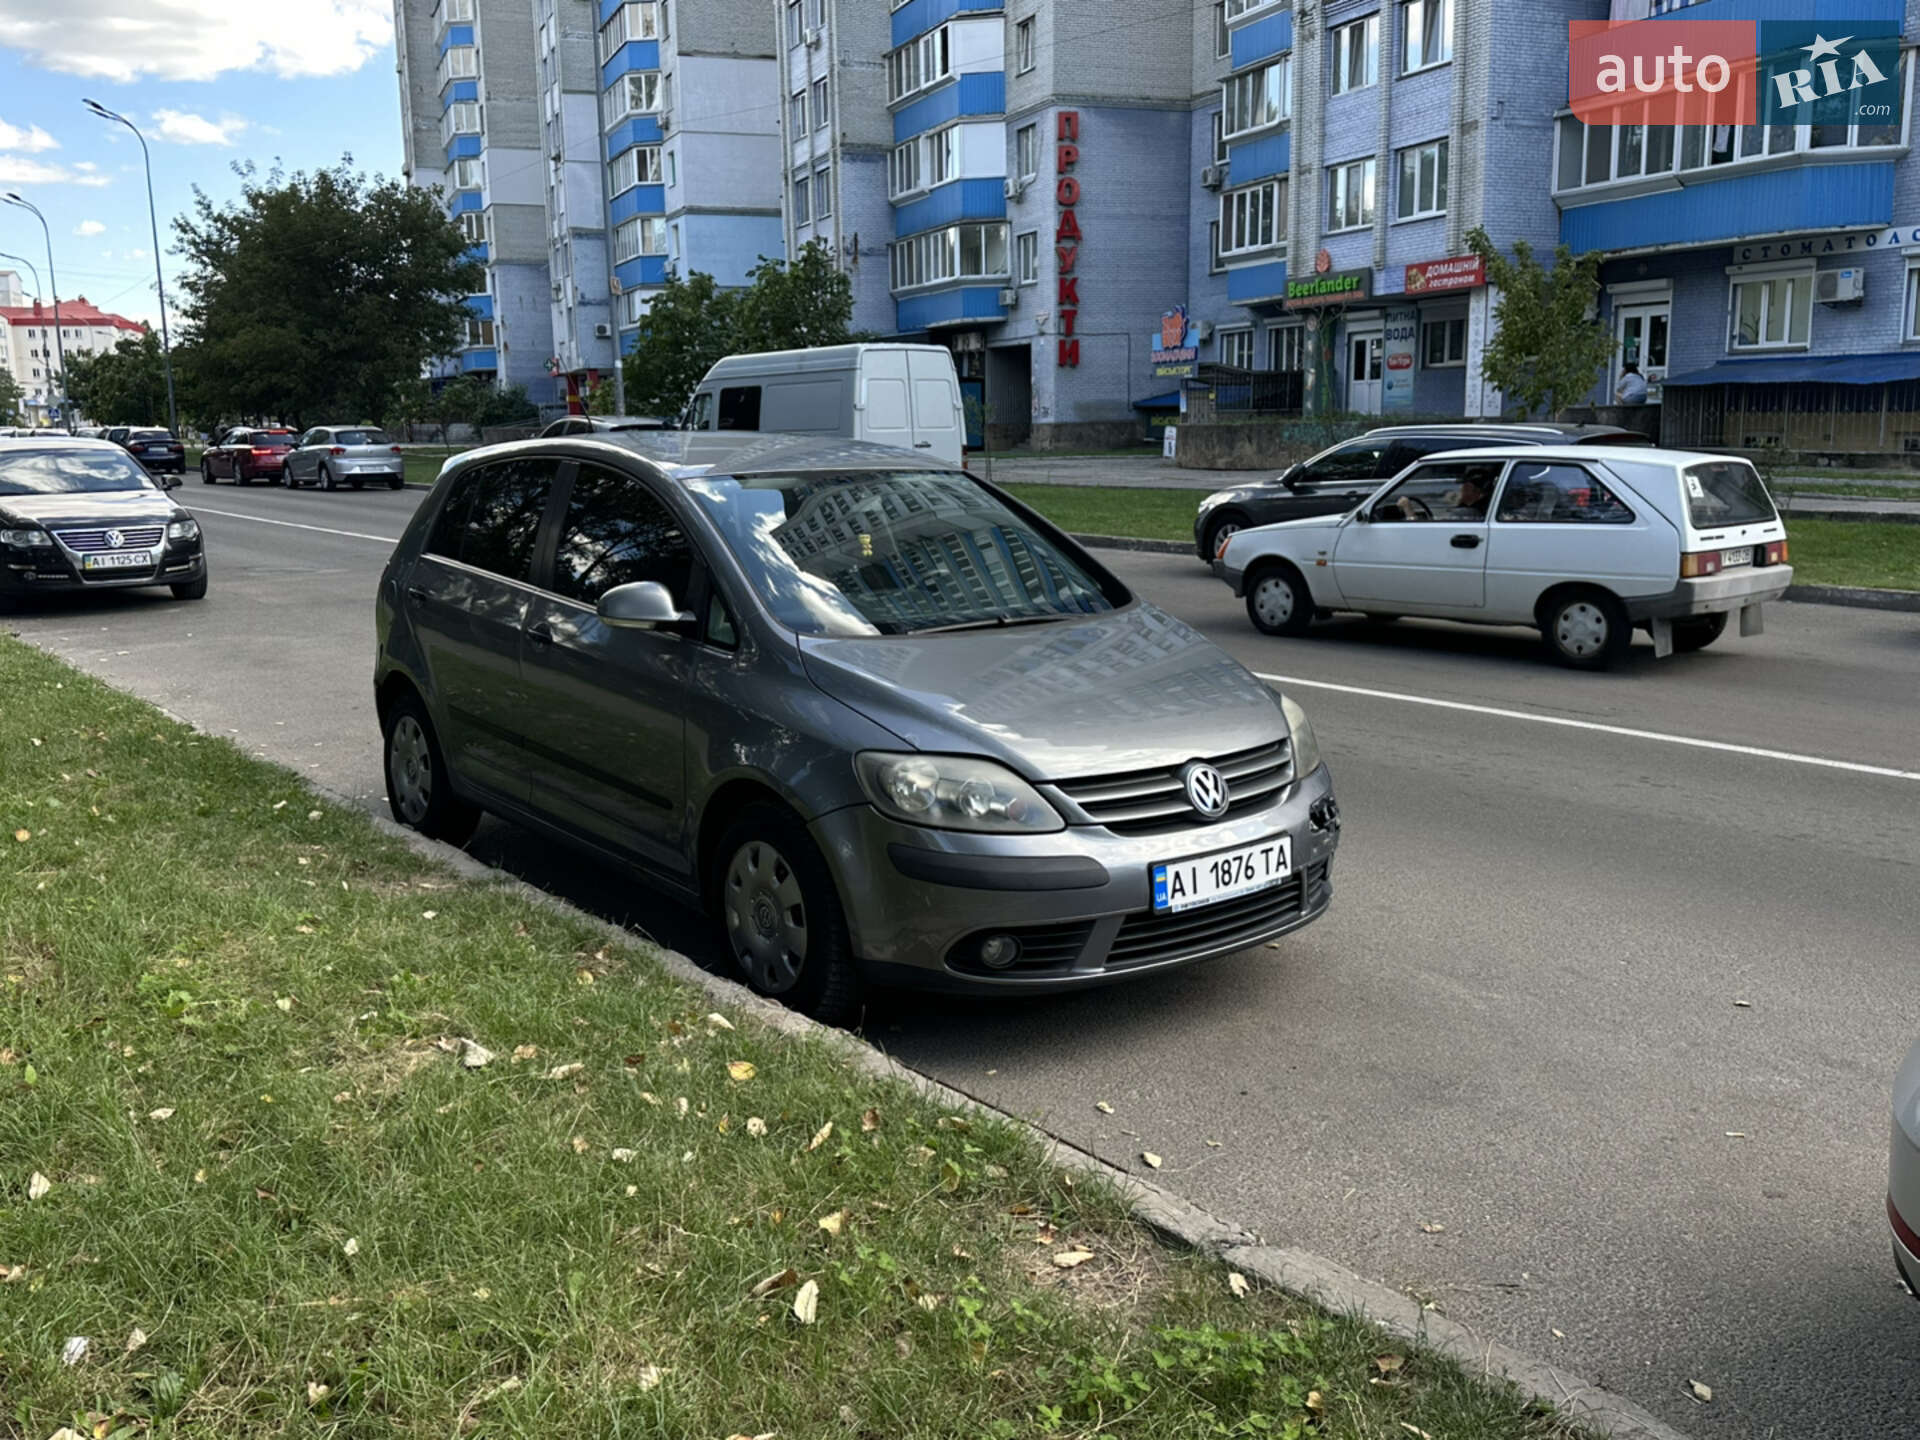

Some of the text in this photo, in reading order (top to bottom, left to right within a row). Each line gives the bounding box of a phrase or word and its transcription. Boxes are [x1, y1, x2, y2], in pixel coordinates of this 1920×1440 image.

[1056, 111, 1081, 369] ПРОДУКТИ
[1288, 274, 1361, 299] Beerlander
[1385, 326, 1415, 342] ВОДА
[1171, 866, 1197, 900] AI
[1210, 853, 1255, 889] 1876
[1260, 844, 1288, 876] TA
